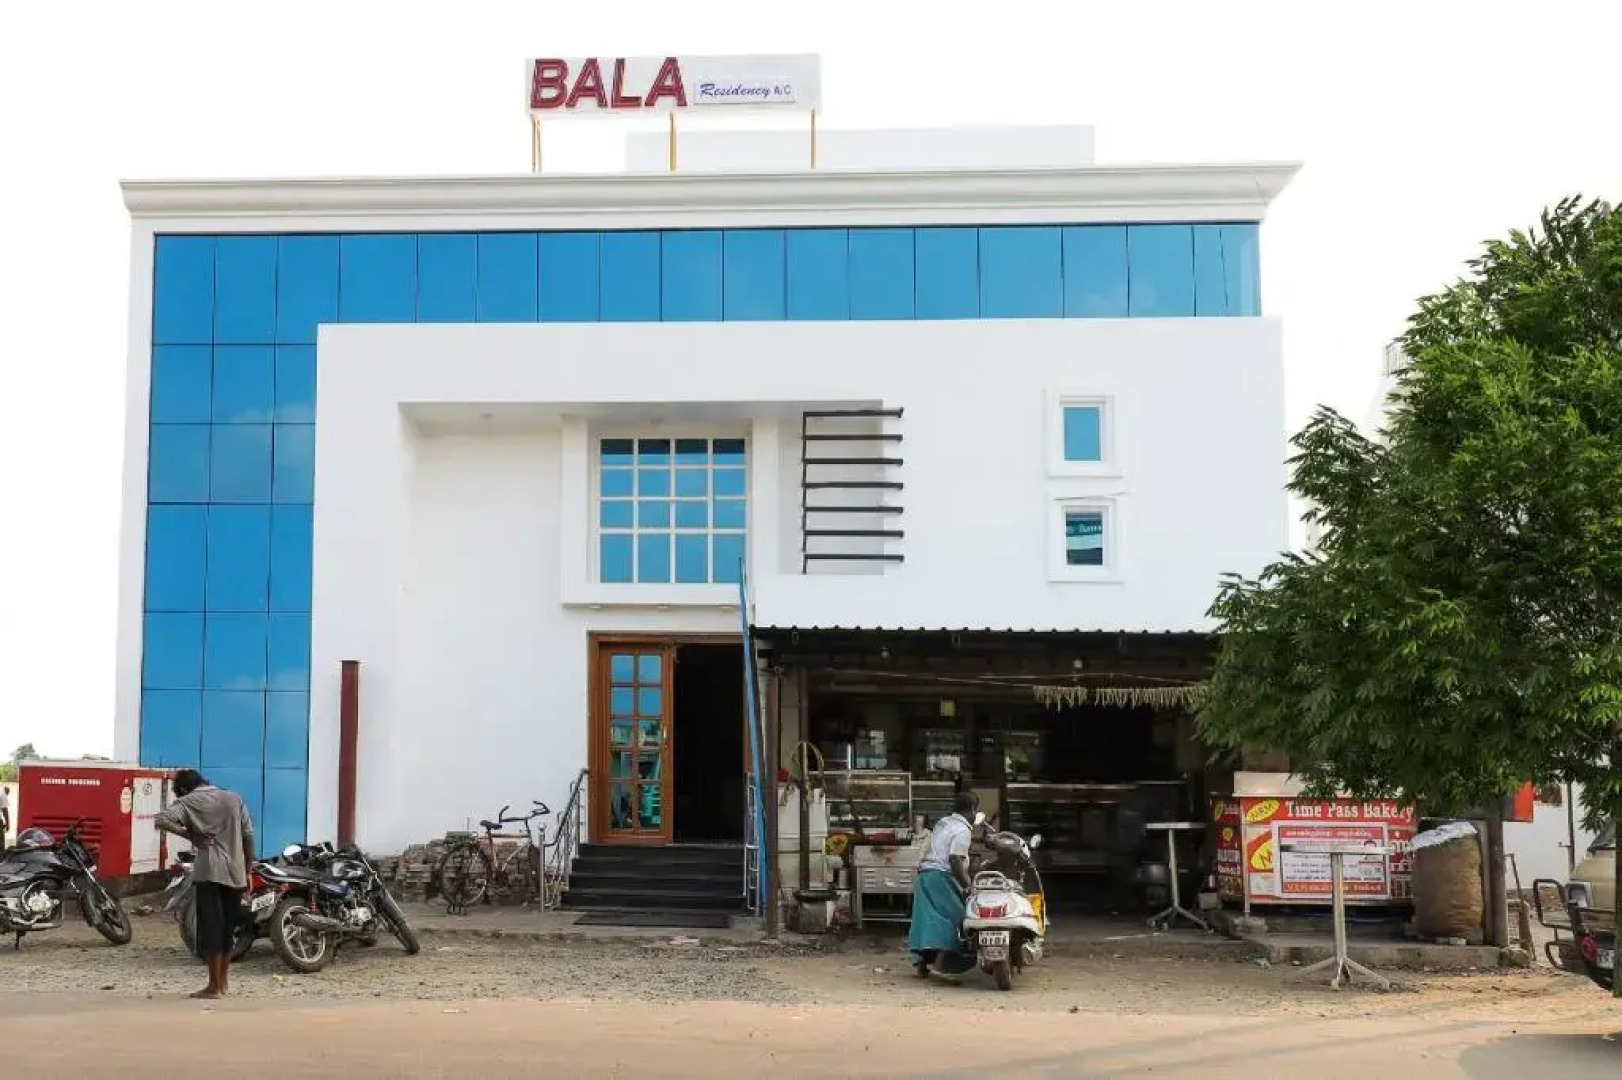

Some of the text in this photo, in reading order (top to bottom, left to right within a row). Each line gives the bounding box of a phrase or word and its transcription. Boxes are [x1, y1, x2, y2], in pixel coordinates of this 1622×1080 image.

[530, 57, 688, 108] BALA
[700, 83, 771, 98] Residency
[1285, 801, 1321, 818] Time
[1326, 801, 1358, 818] Pass
